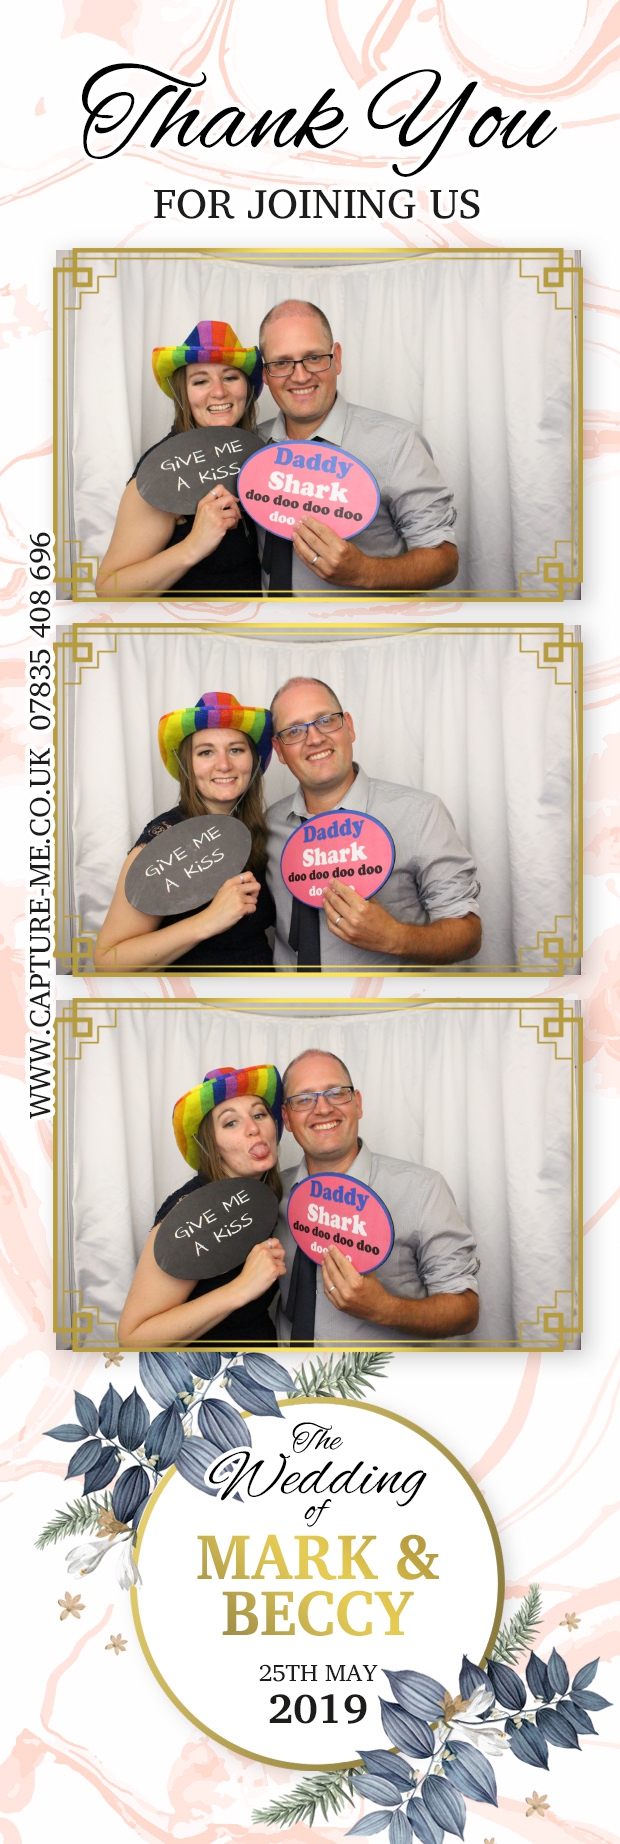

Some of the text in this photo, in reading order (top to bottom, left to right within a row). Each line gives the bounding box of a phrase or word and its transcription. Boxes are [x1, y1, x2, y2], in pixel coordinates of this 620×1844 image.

[214, 439, 243, 458] ME
[273, 447, 354, 479] Daddy
[177, 476, 191, 492] A
[268, 471, 348, 503] Shark
[245, 489, 363, 521] doo doo doo doo
[269, 511, 295, 526] doo
[192, 826, 222, 849] ME
[303, 818, 365, 843] Daddy
[302, 842, 368, 867] Shark
[288, 864, 383, 882] doo doo doo doo
[165, 878, 180, 893] A
[222, 1189, 251, 1213] ME
[310, 1180, 370, 1212] Daddy
[307, 1203, 368, 1237] Shark
[194, 1241, 210, 1257] A
[293, 1221, 380, 1256] doo doo doo doo
